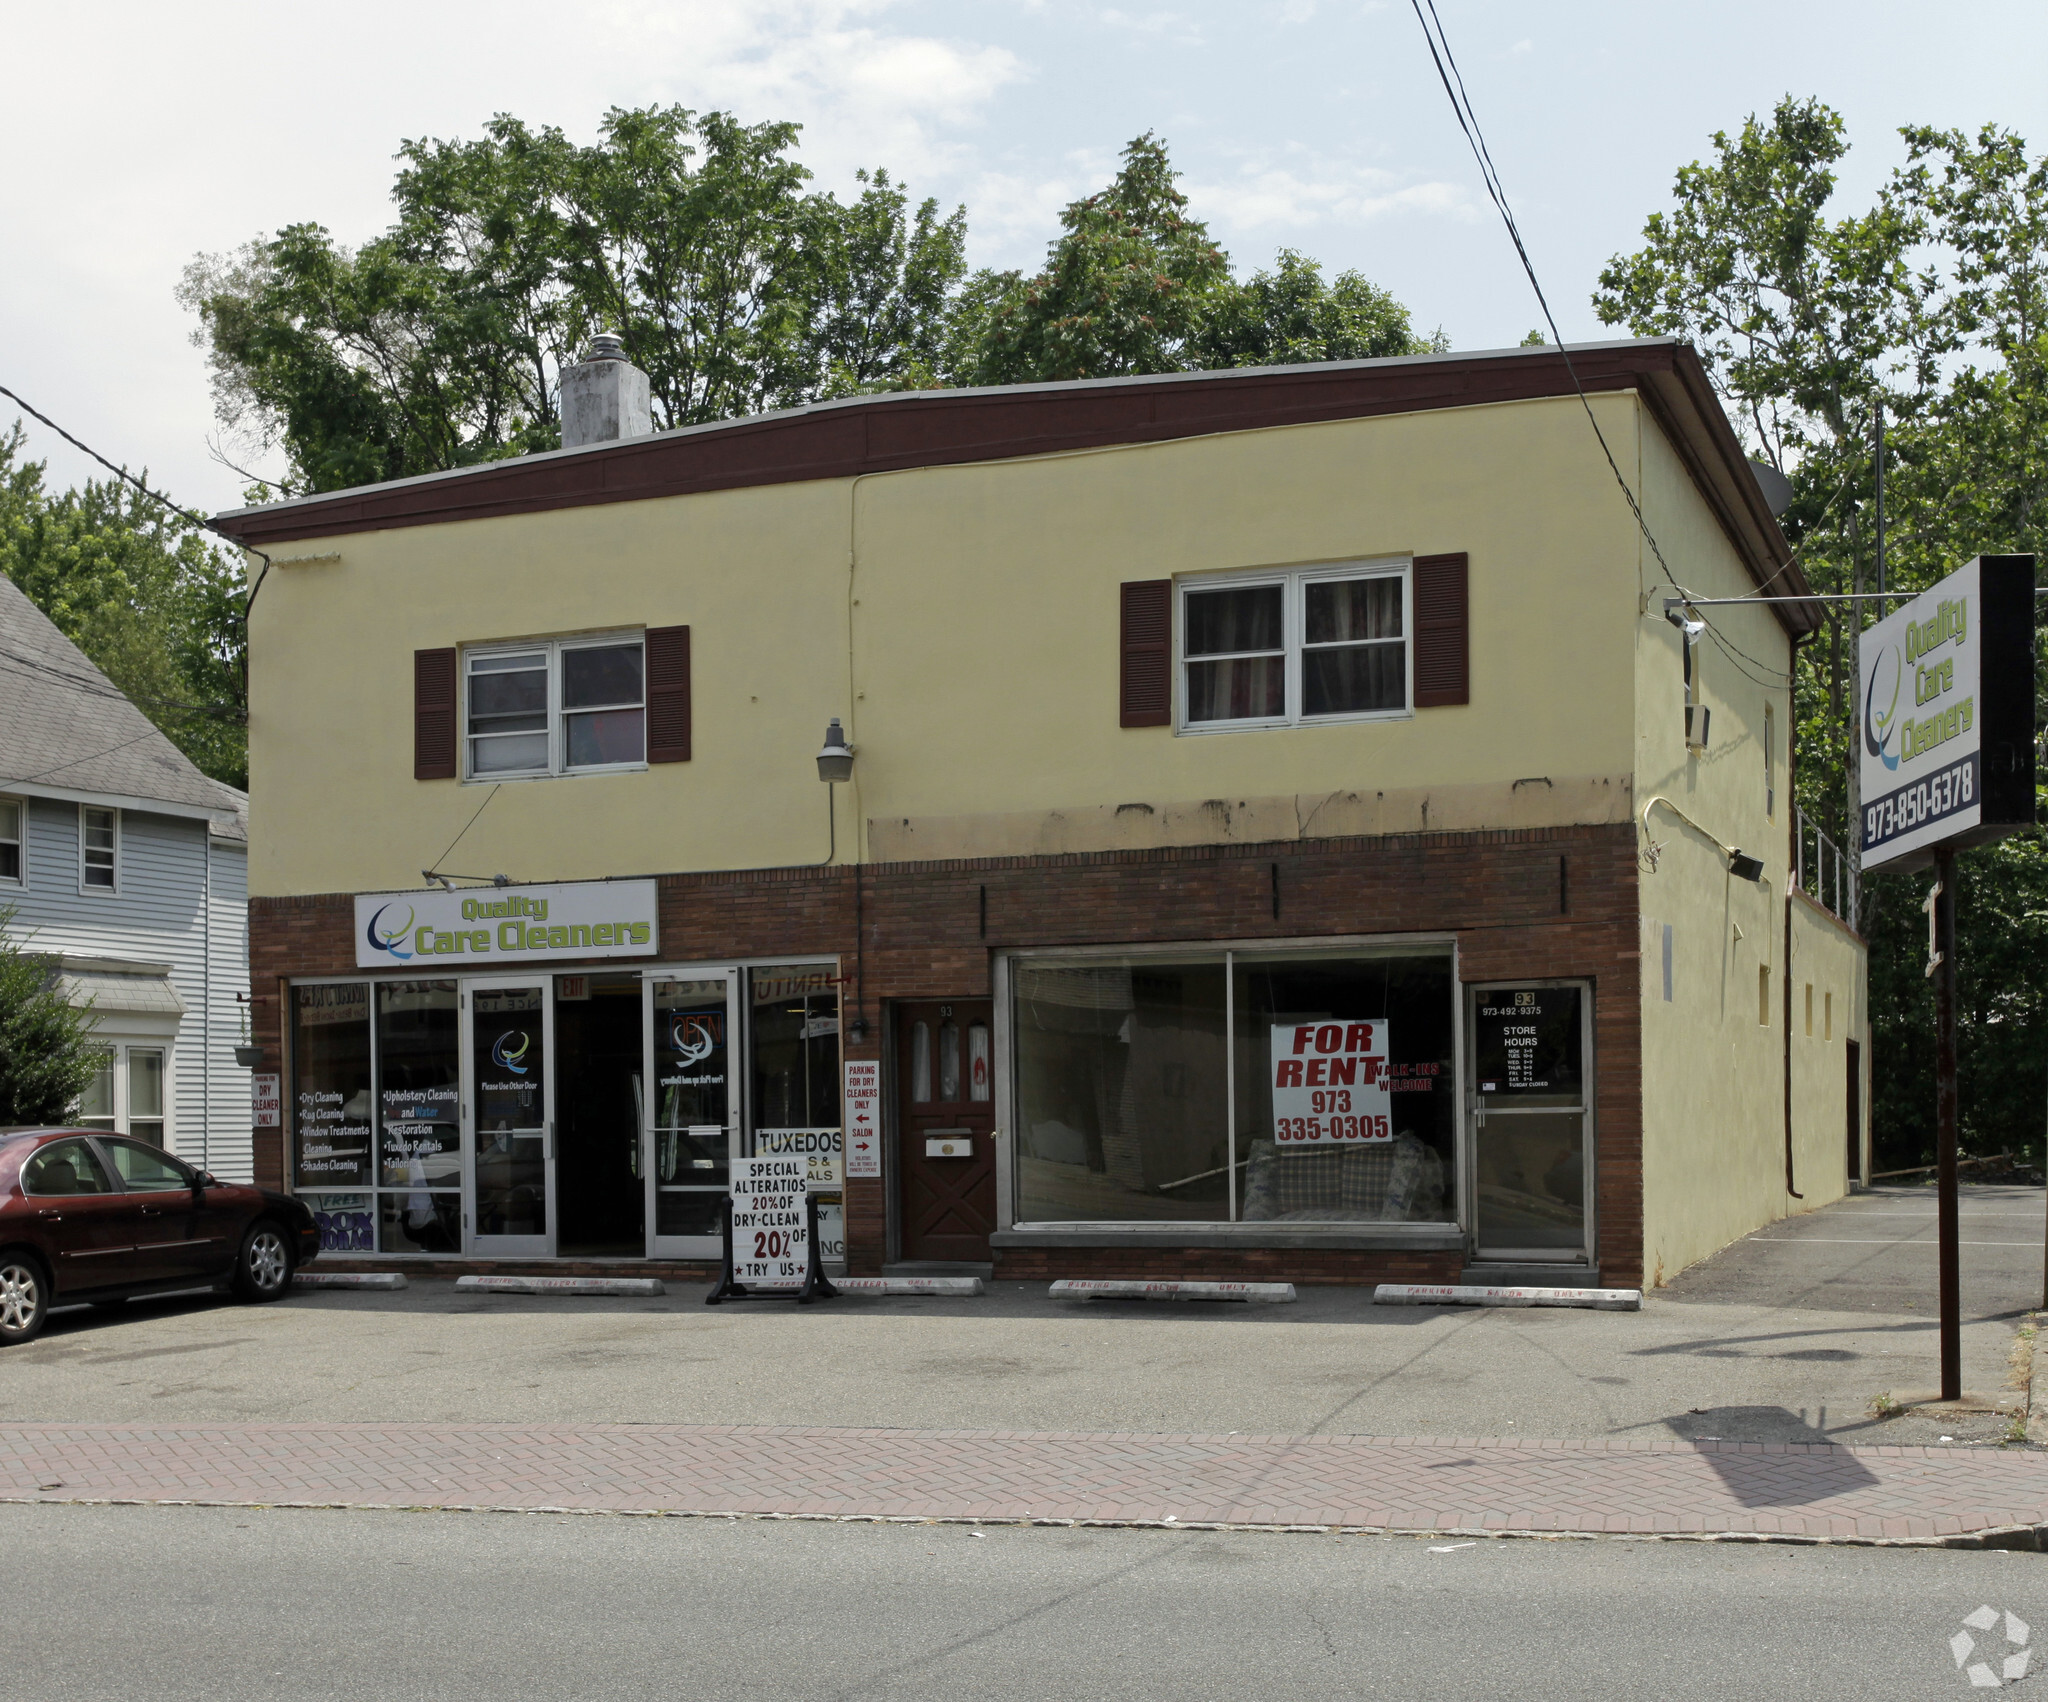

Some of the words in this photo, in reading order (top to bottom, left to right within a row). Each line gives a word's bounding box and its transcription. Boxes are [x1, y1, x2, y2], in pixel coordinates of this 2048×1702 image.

[1905, 596, 1968, 667] Quality
[1915, 656, 1954, 707] Care
[1900, 695, 1974, 764] Cleaners
[1866, 761, 1974, 844] 973-850-6378
[461, 895, 549, 921] Quality
[415, 926, 491, 955] Care
[497, 920, 651, 951] Cleaners
[563, 977, 584, 997] EXIT
[1516, 993, 1534, 1005] 93
[672, 1015, 721, 1045] OPEN
[1503, 1026, 1536, 1035] STORE
[1292, 1023, 1374, 1055] FOR
[1504, 1037, 1538, 1047] HOURS
[849, 1065, 875, 1075] PARKING
[1275, 1056, 1386, 1088] RENT
[1370, 1063, 1440, 1077] WALK-INS
[849, 1077, 861, 1087] FOR
[862, 1077, 875, 1086] DRY
[1378, 1078, 1433, 1092] WELCOME
[259, 1085, 271, 1096] DRY
[386, 1090, 427, 1105] Upholstery
[427, 1089, 458, 1103] Cleaning
[846, 1088, 878, 1098] CLEANERS
[252, 1099, 279, 1111] CLEANER
[302, 1092, 314, 1105] Dry
[315, 1091, 343, 1104] Cleaning
[854, 1100, 870, 1110] ONLY
[1311, 1090, 1352, 1114] 973
[258, 1113, 273, 1125] ONLY
[302, 1110, 315, 1122] Rug
[316, 1108, 345, 1121] Cleaning
[401, 1106, 415, 1118] and
[415, 1106, 439, 1118] Water
[302, 1125, 328, 1136] Window
[329, 1124, 370, 1136] Treatments
[388, 1124, 433, 1135] Restoration
[852, 1128, 873, 1138] SALON
[1277, 1115, 1389, 1141] 335-0305
[304, 1142, 333, 1155] Cleaning
[387, 1140, 412, 1152] Tuxedo
[413, 1140, 443, 1151] Rentals
[759, 1132, 842, 1153] TUXEDOS
[303, 1160, 329, 1171] Shades
[330, 1159, 358, 1173] Cleaning
[387, 1158, 420, 1171] Tailoring
[750, 1162, 800, 1177] SPECIAL
[734, 1179, 806, 1194] ALTERATIOS
[323, 1193, 360, 1207] FREE
[314, 1211, 374, 1231] BOX
[734, 1212, 799, 1227] DRY-CLEAN
[754, 1230, 791, 1259] 20%
[792, 1229, 807, 1242] OF
[746, 1263, 768, 1277] TRY
[780, 1262, 795, 1276] US
[1407, 1285, 1454, 1294] PARKING
